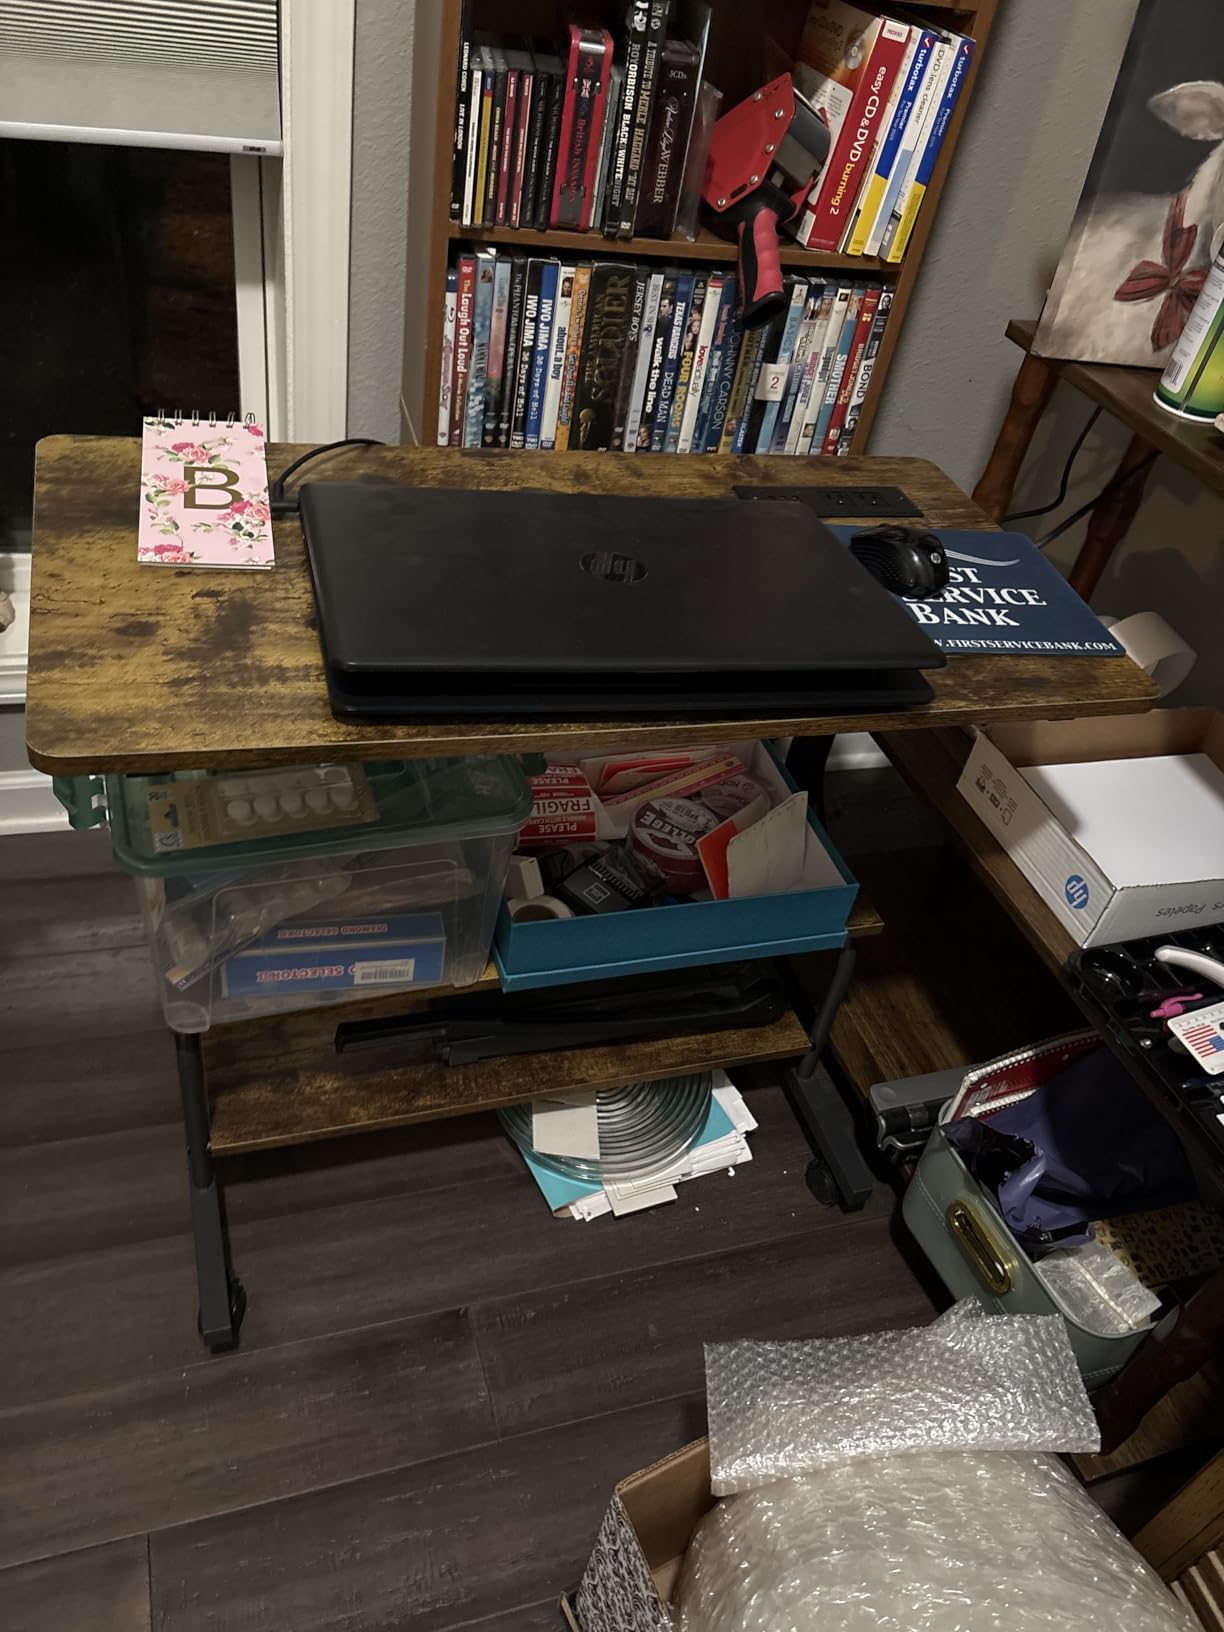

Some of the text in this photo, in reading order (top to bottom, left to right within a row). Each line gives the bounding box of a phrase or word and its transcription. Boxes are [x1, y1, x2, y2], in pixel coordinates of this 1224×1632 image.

[643, 50, 656, 79] TRIBUTE
[642, 81, 652, 90] TO
[870, 66, 886, 94] easy
[898, 49, 928, 130] turbotax Premier
[914, 50, 945, 125] DVD lens cleaner
[636, 90, 651, 124] MERLE
[938, 56, 966, 136] turbotax Premier
[629, 128, 644, 170] HAGGARD
[832, 163, 855, 206] burning
[458, 293, 472, 326] Laugh
[511, 284, 522, 326] PHANTOM
[526, 294, 538, 318] IWO
[540, 299, 552, 322] IWO
[629, 280, 646, 342] JERSEY BOYS
[459, 328, 470, 346] Out
[522, 318, 536, 347] JIMA
[536, 322, 550, 351] JIMA
[554, 326, 566, 356] about
[668, 302, 686, 360] TEXAS RANGERS
[456, 347, 468, 372] Loud
[506, 341, 516, 370] OPERA
[726, 332, 742, 379] JOHNNY
[806, 352, 819, 381] BRIDGET
[851, 344, 864, 374] BRIDGET
[519, 364, 528, 384] Days
[533, 368, 542, 387] Days
[551, 364, 563, 380] boy
[646, 337, 664, 414] walk the line
[770, 376, 780, 389] 2
[825, 354, 847, 404] SMOTHER
[856, 364, 873, 398] BOND
[518, 386, 526, 397] of
[532, 390, 540, 400] of
[656, 372, 674, 424] DEAD MAN
[672, 351, 693, 428] FOUR ROOMS
[800, 382, 810, 404] JONES
[516, 398, 524, 417] Hell
[530, 402, 538, 420] Hell
[712, 381, 731, 430] CARSON
[736, 422, 747, 448] BLASTER
[184, 466, 244, 510] B
[902, 586, 1047, 606] RVICE
[906, 603, 1020, 626] BANK
[538, 822, 577, 832] PLEASE
